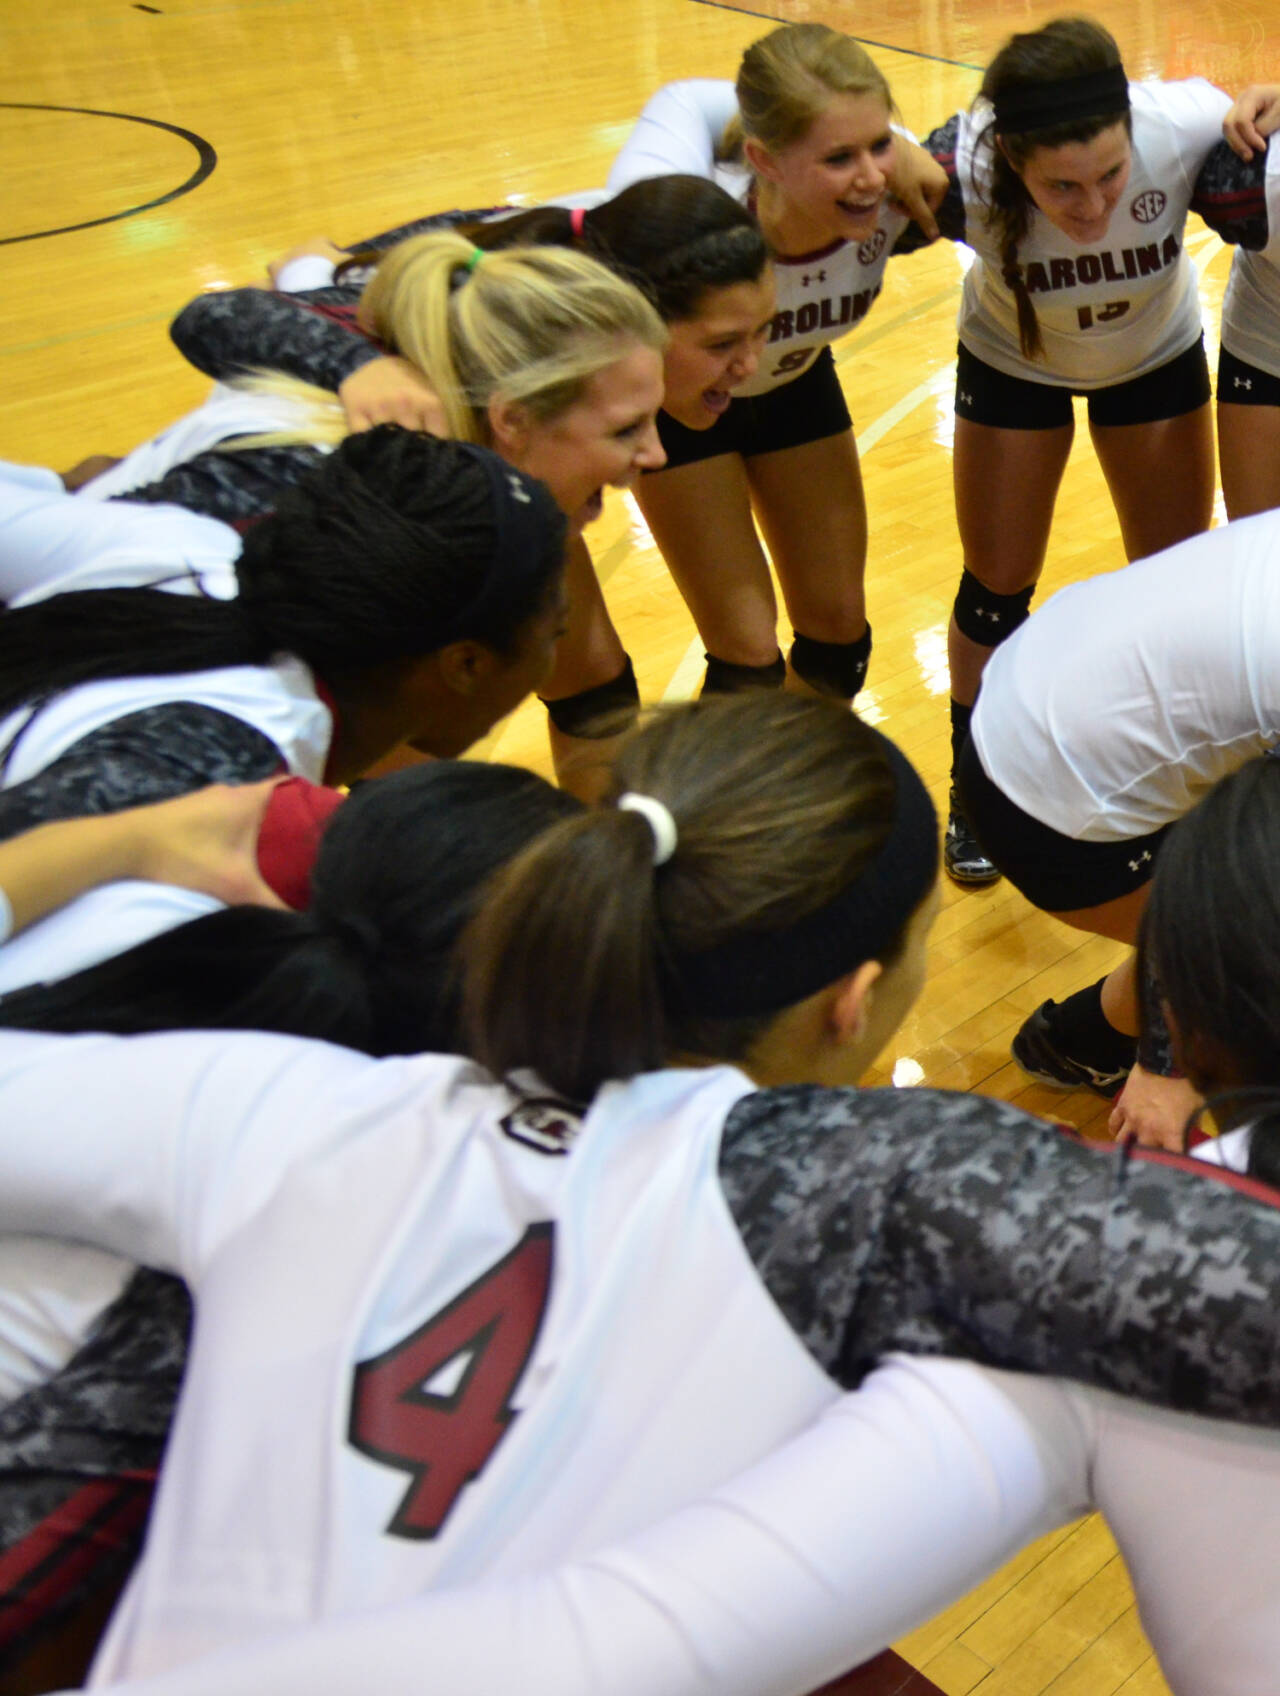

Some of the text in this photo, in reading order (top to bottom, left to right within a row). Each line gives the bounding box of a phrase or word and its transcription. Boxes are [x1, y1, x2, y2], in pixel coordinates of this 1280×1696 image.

[1132, 191, 1168, 222] SEC
[1023, 234, 1179, 294] AROLINA
[346, 1220, 556, 1542] 4
